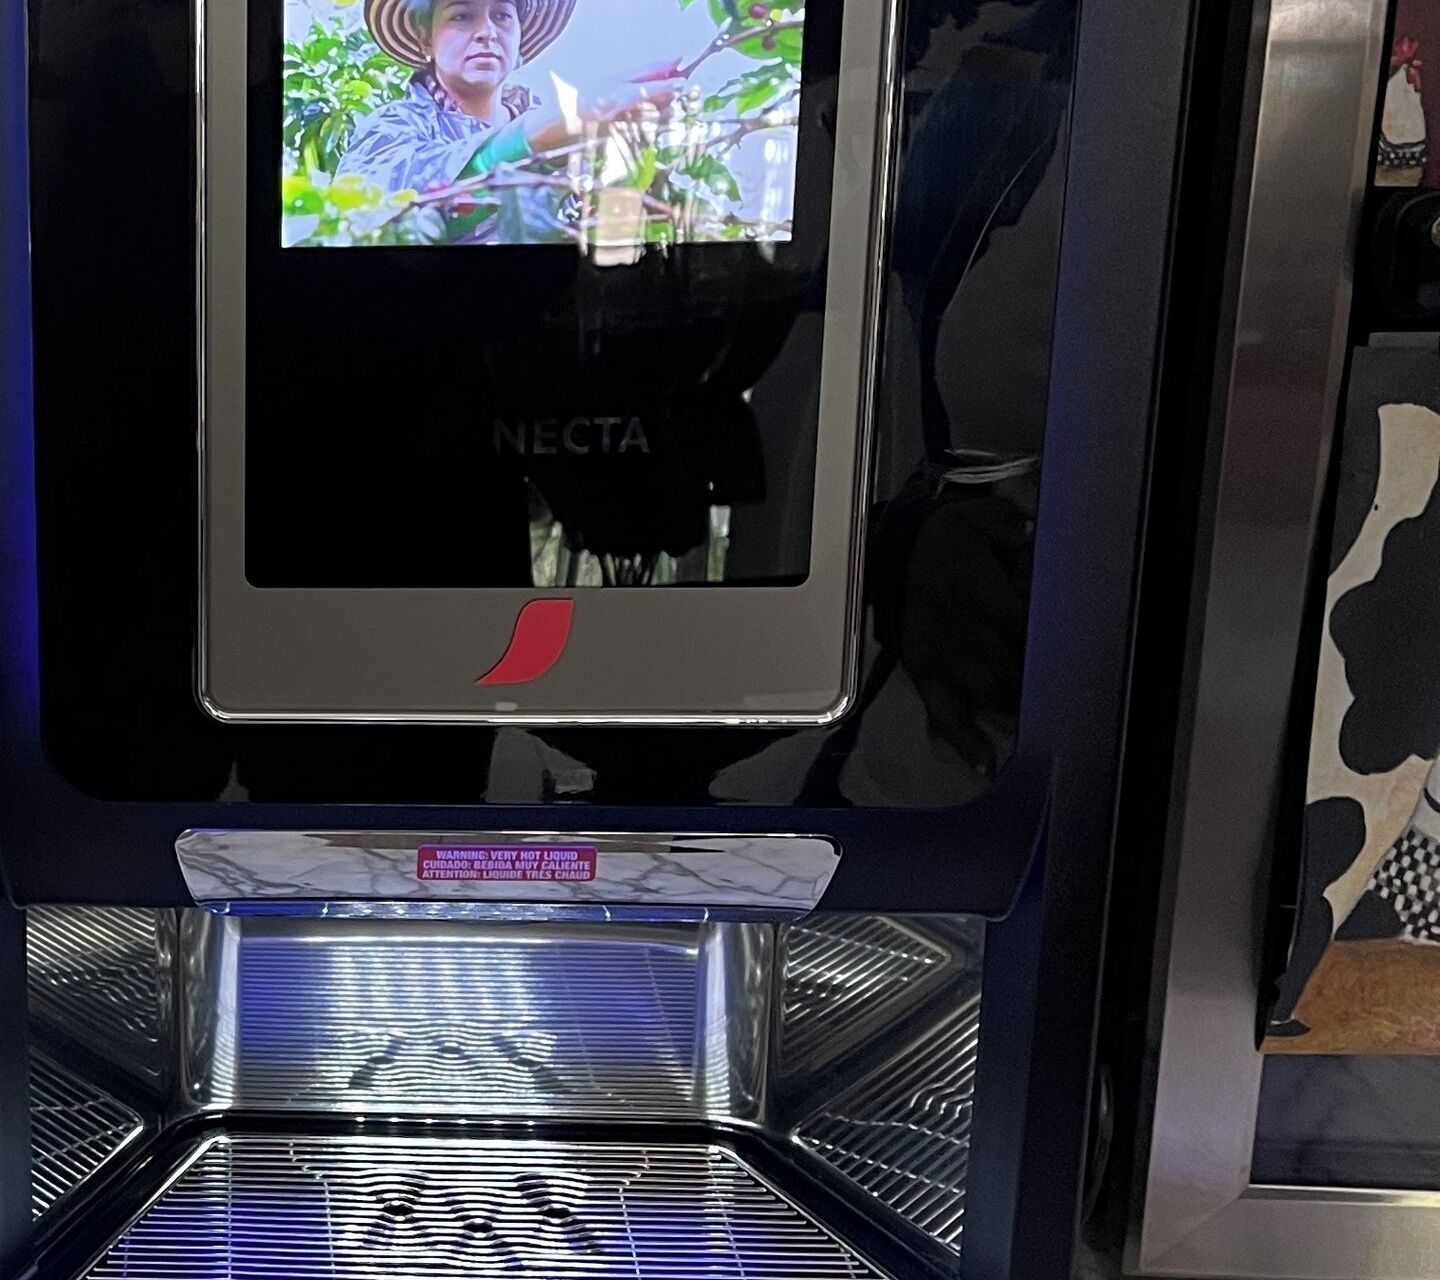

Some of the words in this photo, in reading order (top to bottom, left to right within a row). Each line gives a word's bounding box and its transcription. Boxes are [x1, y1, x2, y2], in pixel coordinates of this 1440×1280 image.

[493, 416, 651, 455] NECTA
[436, 850, 489, 860] WARNING:
[490, 850, 518, 860] VERY
[521, 851, 541, 861] HOT
[543, 851, 578, 861] LIQUID
[473, 860, 513, 870] BEBIDA
[515, 861, 539, 870] MUY
[541, 861, 591, 871] CALIENTE
[482, 870, 524, 880] LIQUIDE
[555, 871, 591, 880] CHAUD
